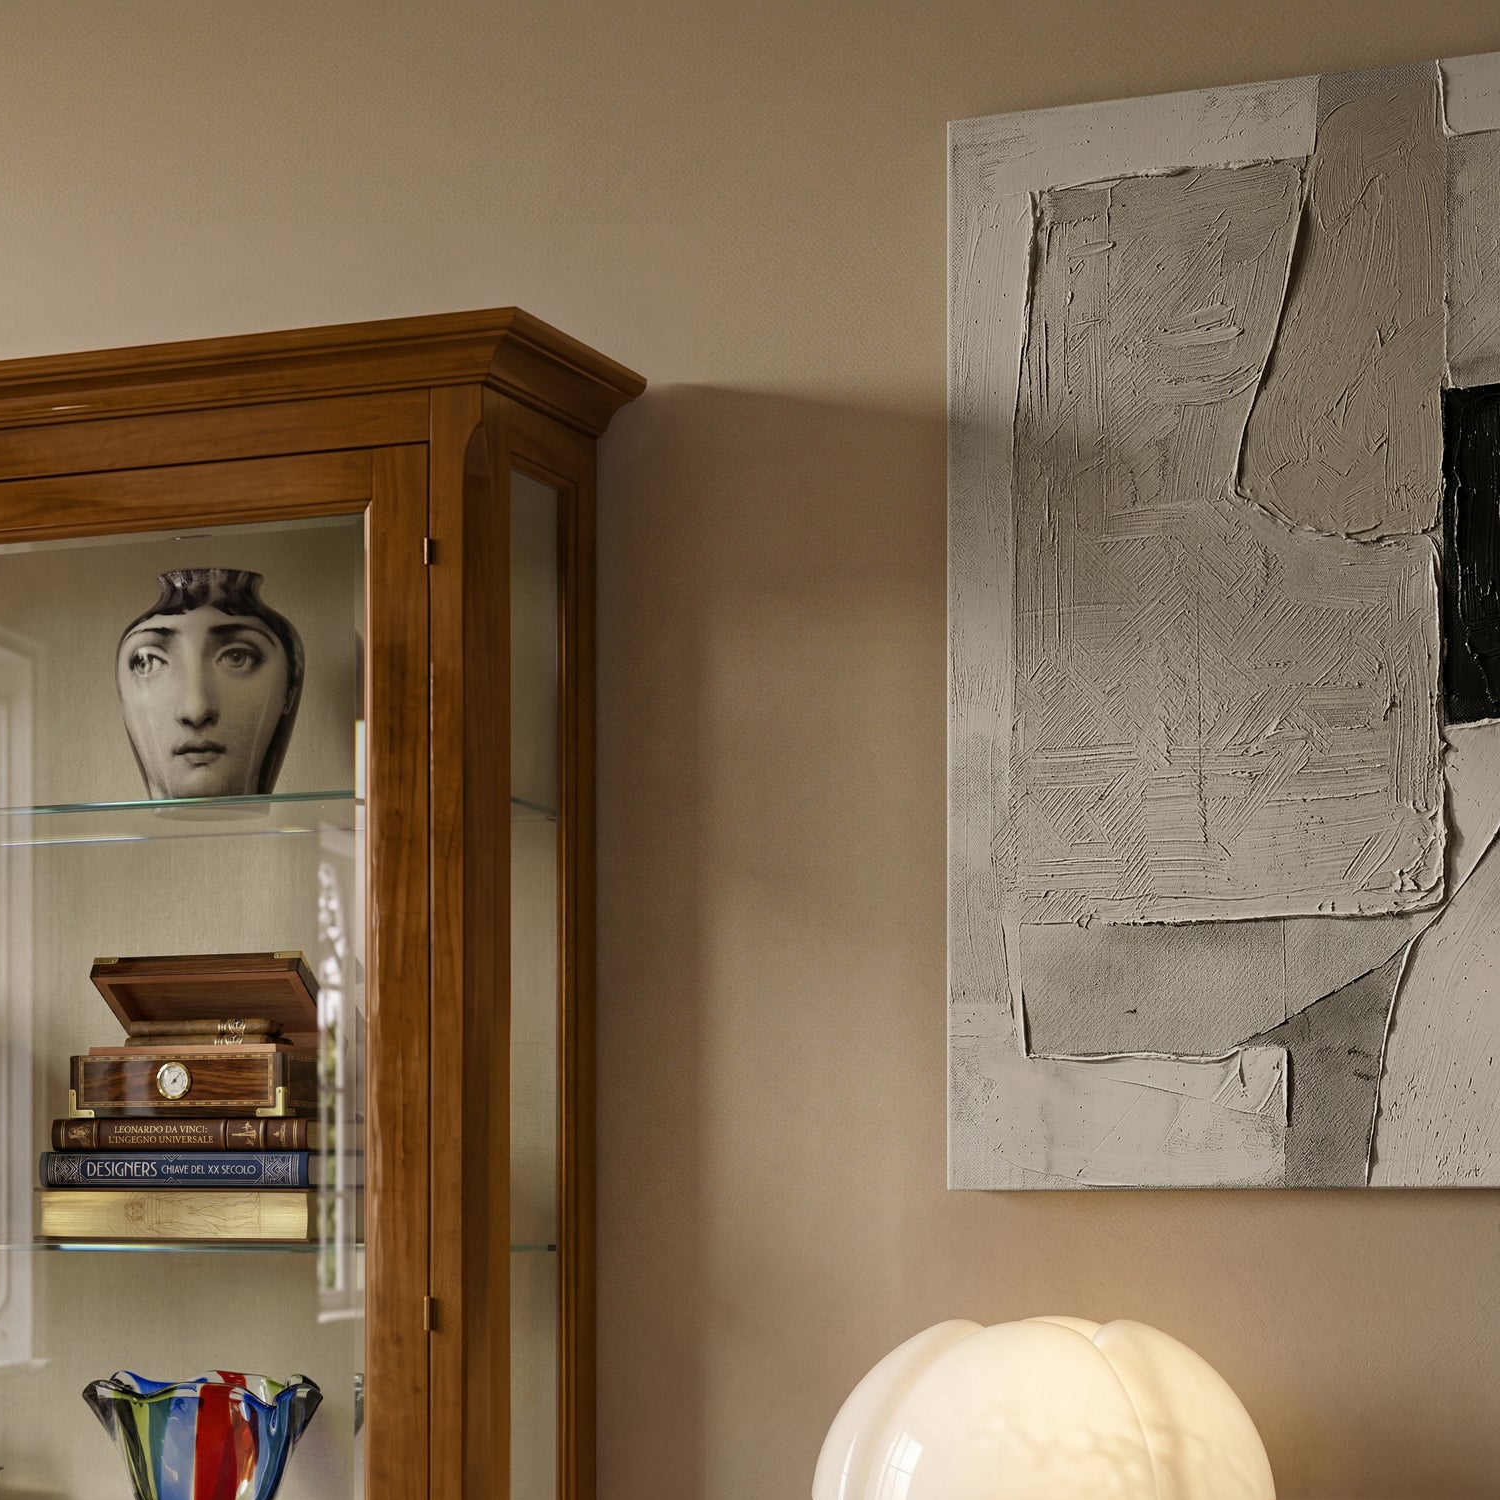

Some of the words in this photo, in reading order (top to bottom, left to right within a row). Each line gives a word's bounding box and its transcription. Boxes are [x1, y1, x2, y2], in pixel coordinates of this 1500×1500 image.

[114, 1125, 164, 1134] LEONARDO
[165, 1125, 178, 1134] DA
[179, 1125, 208, 1134] VINCI:
[108, 1135, 157, 1144] L'INGEGNO
[159, 1135, 214, 1144] UNIVERSALE
[86, 1161, 158, 1177] DESIGNERS
[161, 1165, 189, 1175] CHIAVE
[191, 1165, 206, 1175] DEL
[207, 1165, 220, 1175] XX
[221, 1165, 256, 1175] SECOLO
